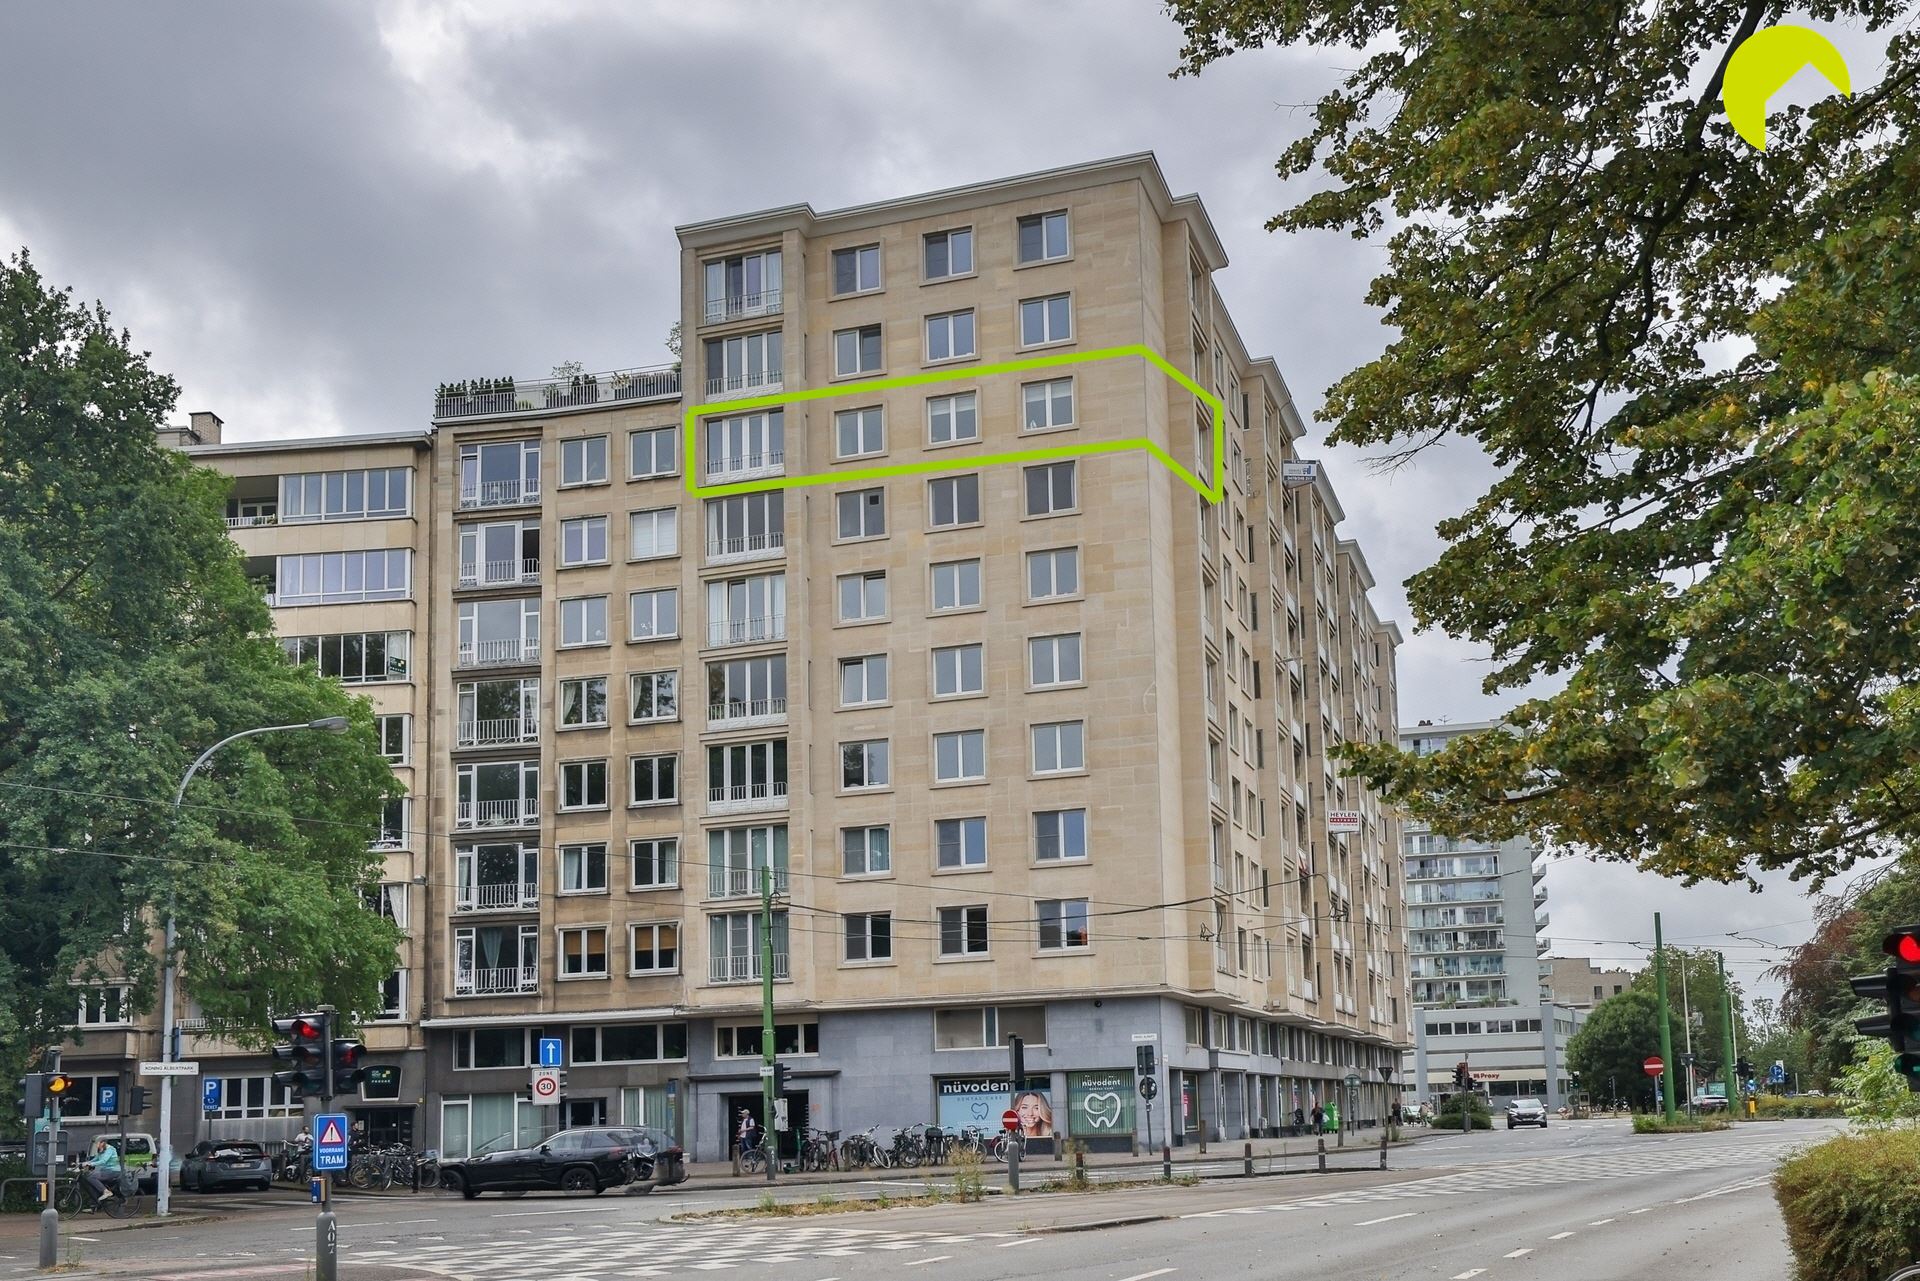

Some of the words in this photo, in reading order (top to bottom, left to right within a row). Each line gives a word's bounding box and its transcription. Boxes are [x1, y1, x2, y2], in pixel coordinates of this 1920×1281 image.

[205, 1081, 217, 1096] P
[541, 1083, 551, 1091] 30
[943, 1080, 1012, 1093] nüvoden
[102, 1090, 114, 1104] P
[320, 1155, 344, 1165] TRAM
